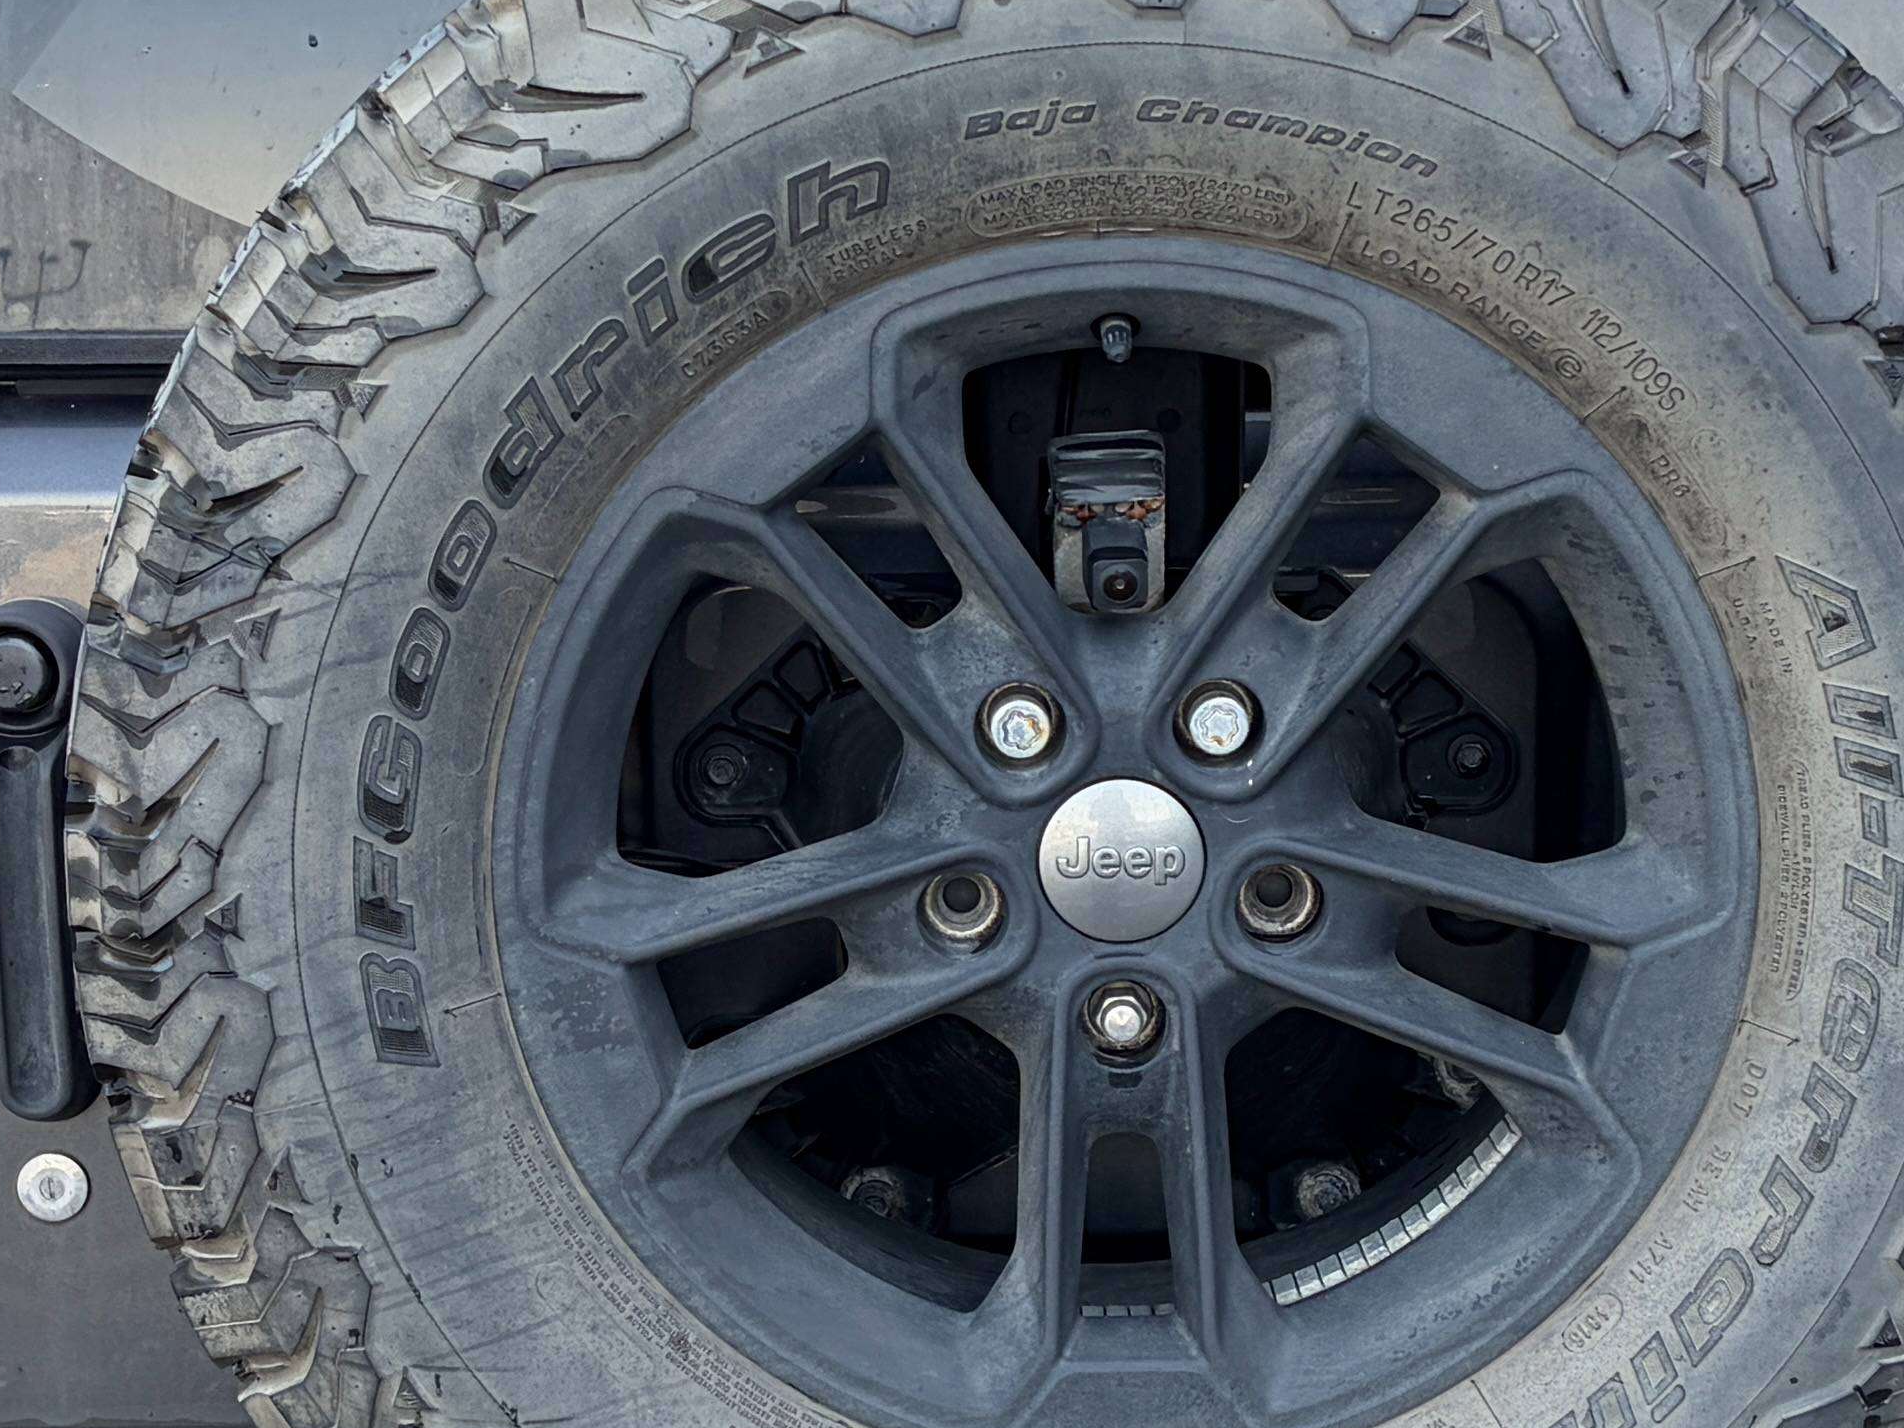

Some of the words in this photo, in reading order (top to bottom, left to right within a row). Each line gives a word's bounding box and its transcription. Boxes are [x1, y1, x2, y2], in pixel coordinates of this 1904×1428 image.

[963, 98, 1098, 141] Baja
[1136, 96, 1440, 177] Champion
[825, 217, 929, 269] TUBELESS
[1358, 239, 1443, 287] LOAD
[1446, 278, 1548, 354] RANGE
[352, 150, 891, 1067] BFGoodrich
[1757, 599, 1785, 650] MADE
[1778, 654, 1795, 675] IN
[1056, 835, 1186, 886] Jeep
[1729, 1061, 1768, 1119] DOT
